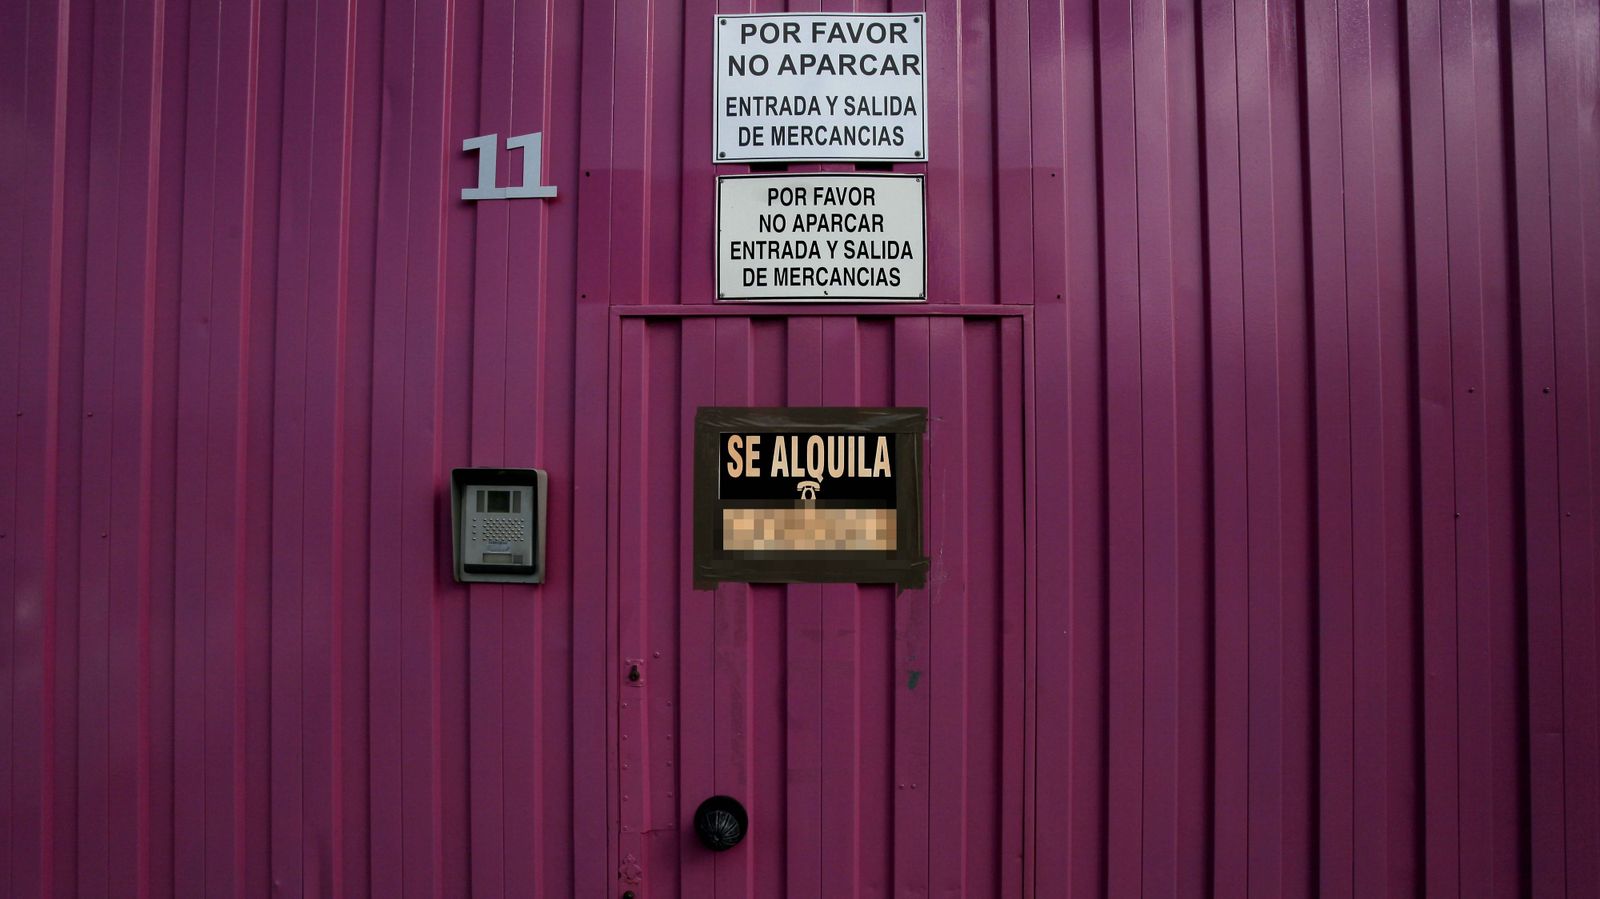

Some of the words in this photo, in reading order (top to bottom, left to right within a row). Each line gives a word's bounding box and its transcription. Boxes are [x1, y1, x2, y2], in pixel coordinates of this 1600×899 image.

[740, 22, 802, 45] POR
[811, 21, 908, 44] FAVOR
[728, 54, 770, 77] NO
[777, 53, 921, 76] APARCAR
[726, 95, 821, 117] ENTRADA
[826, 95, 839, 116] Y
[844, 95, 918, 116] SALIDA
[738, 126, 764, 147] DE
[771, 125, 905, 147] MERCANCIAS
[461, 131, 558, 200] 11
[767, 186, 807, 206] POR
[813, 186, 876, 206] FAVOR
[759, 213, 786, 233] NO
[792, 213, 884, 233] APARCAR
[730, 240, 821, 260] ENTRADA
[826, 240, 839, 259] Y
[843, 239, 914, 260] SALIDA
[743, 267, 767, 287] DE
[774, 267, 901, 287] MERCANCIAS
[726, 434, 761, 479] SE
[770, 434, 892, 484] ALQUILA
